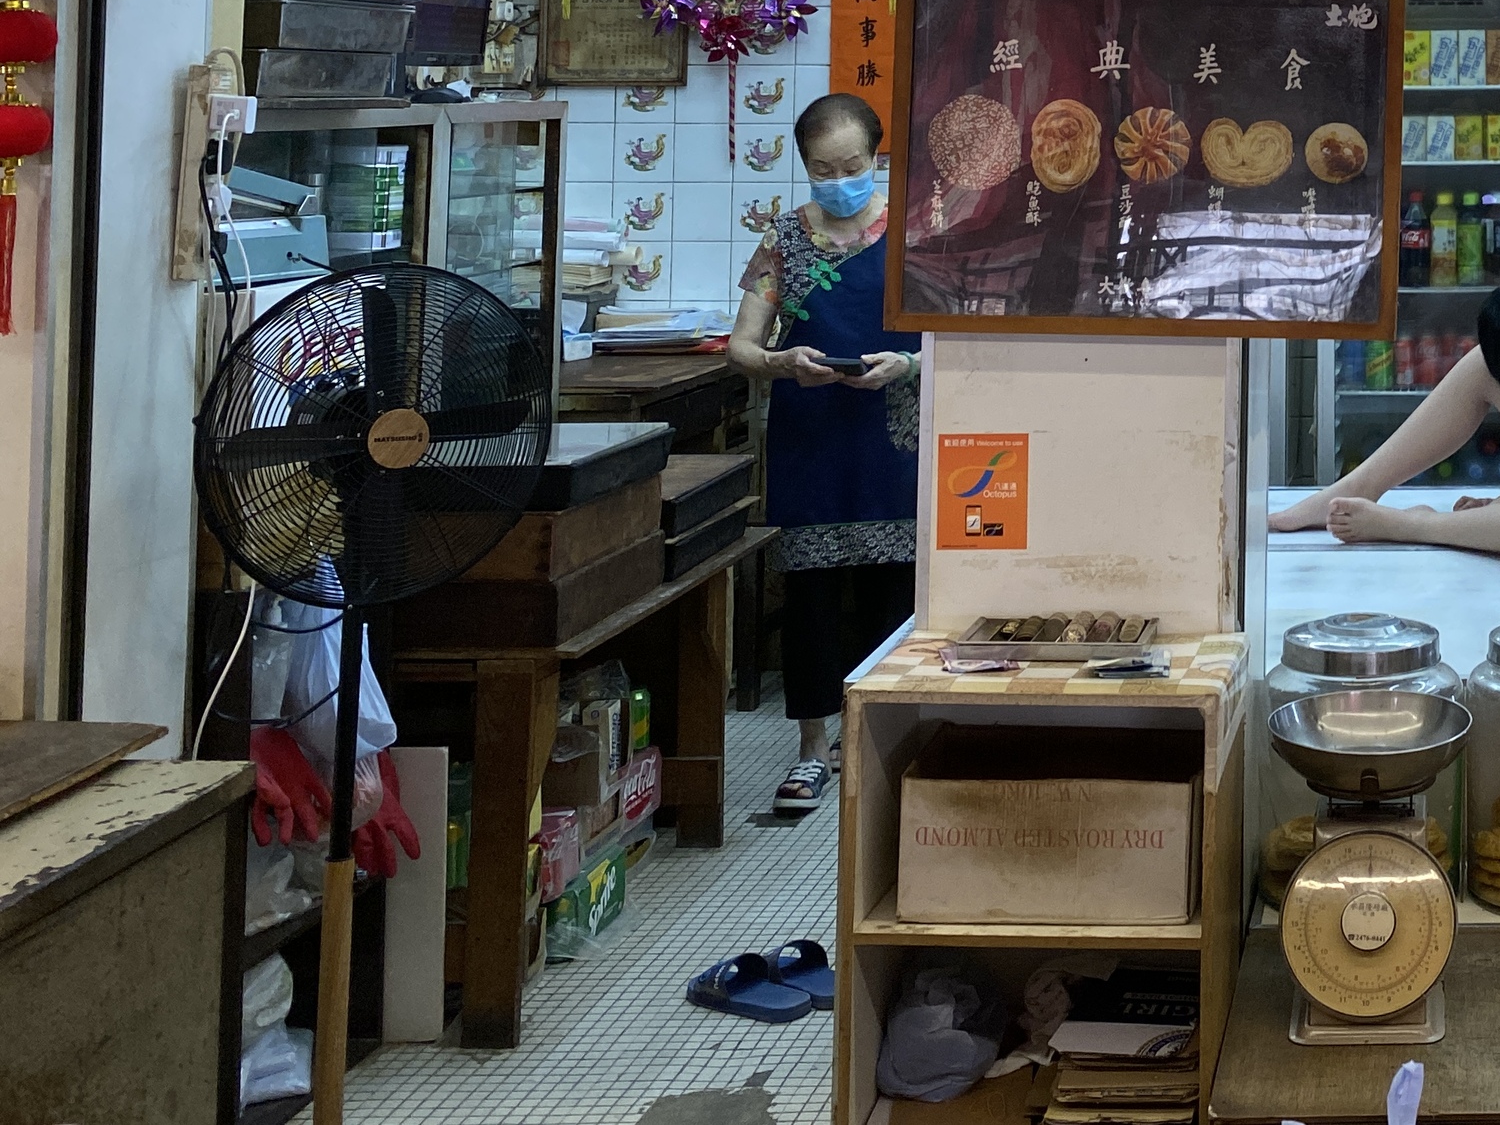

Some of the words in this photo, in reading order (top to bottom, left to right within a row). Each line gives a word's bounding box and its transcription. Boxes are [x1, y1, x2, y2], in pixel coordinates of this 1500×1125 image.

[983, 490, 1017, 499] Octopus
[914, 825, 1008, 848] ALMOND
[1013, 827, 1114, 849] ROASTED
[1120, 829, 1165, 849] DRY
